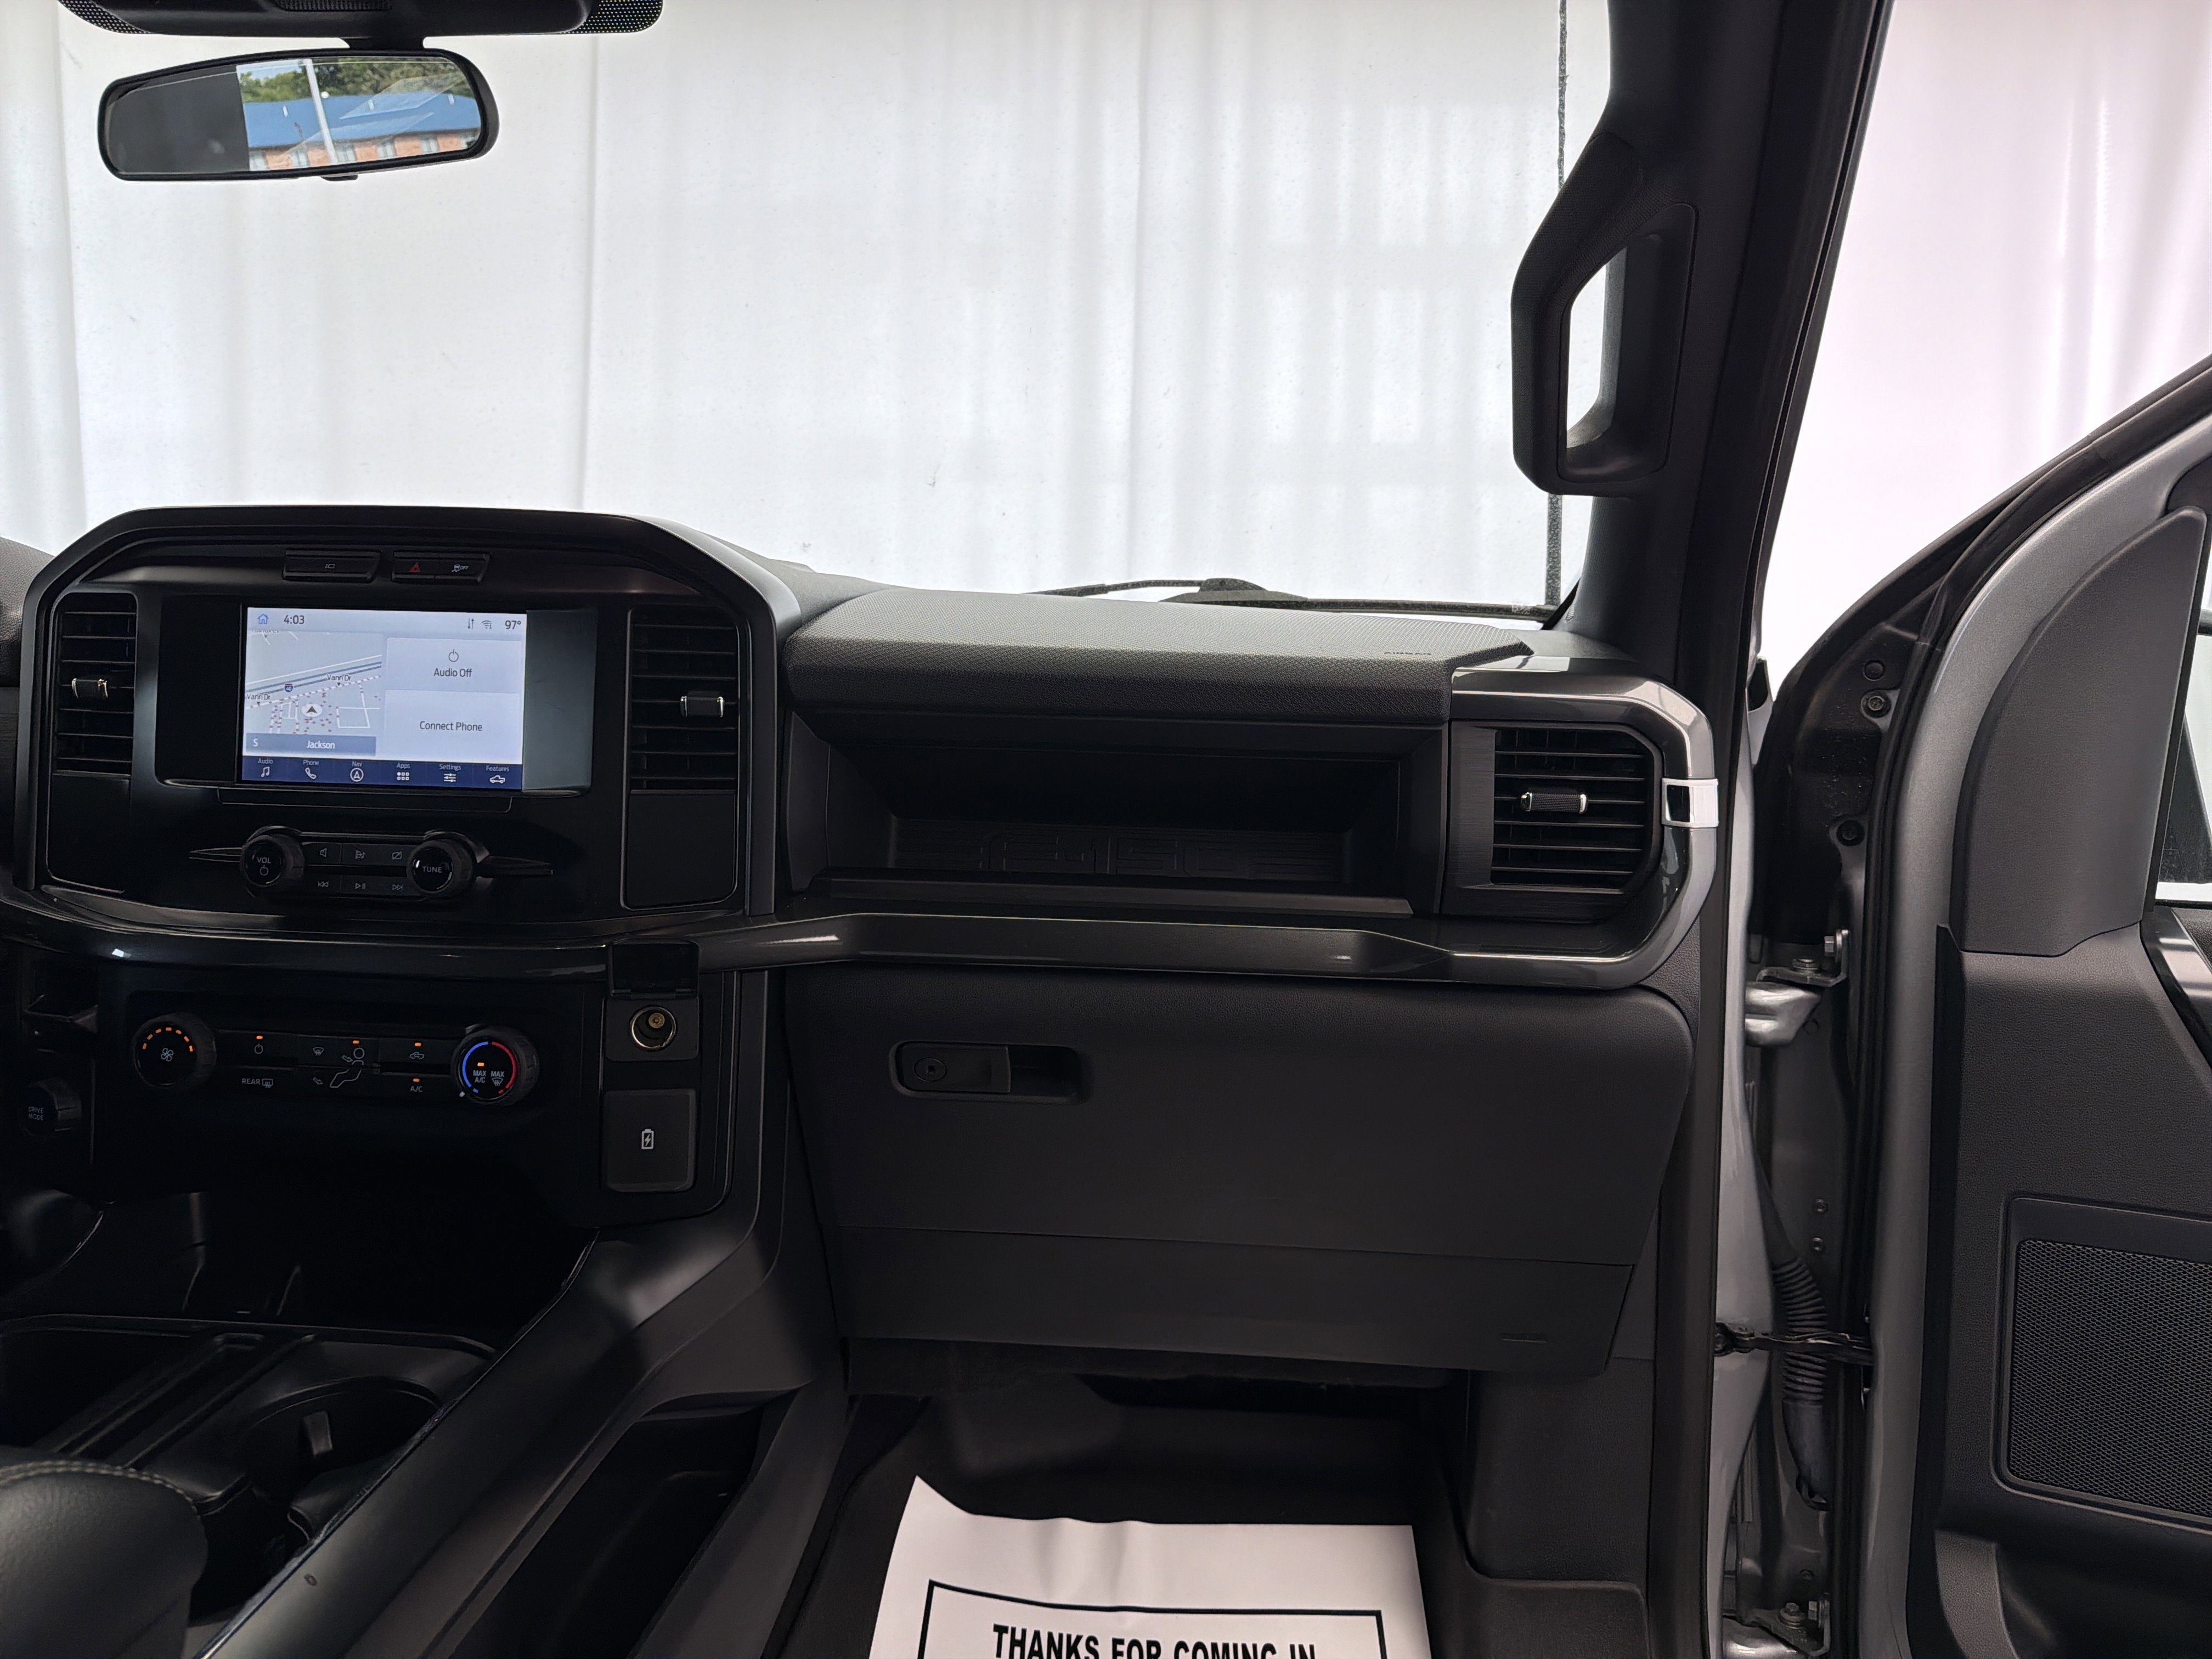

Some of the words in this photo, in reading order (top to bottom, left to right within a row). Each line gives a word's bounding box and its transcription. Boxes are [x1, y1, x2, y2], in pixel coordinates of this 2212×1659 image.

[284, 615, 304, 624] 4:03
[505, 620, 521, 629] 97°
[434, 668, 458, 677] Audio
[459, 668, 472, 677] Off
[420, 721, 454, 730] Connect
[455, 722, 483, 731] Phone
[253, 738, 258, 747] S
[306, 741, 335, 750] Jackson
[993, 1623, 1099, 1659] THANKS
[1112, 1638, 1161, 1659] FOR
